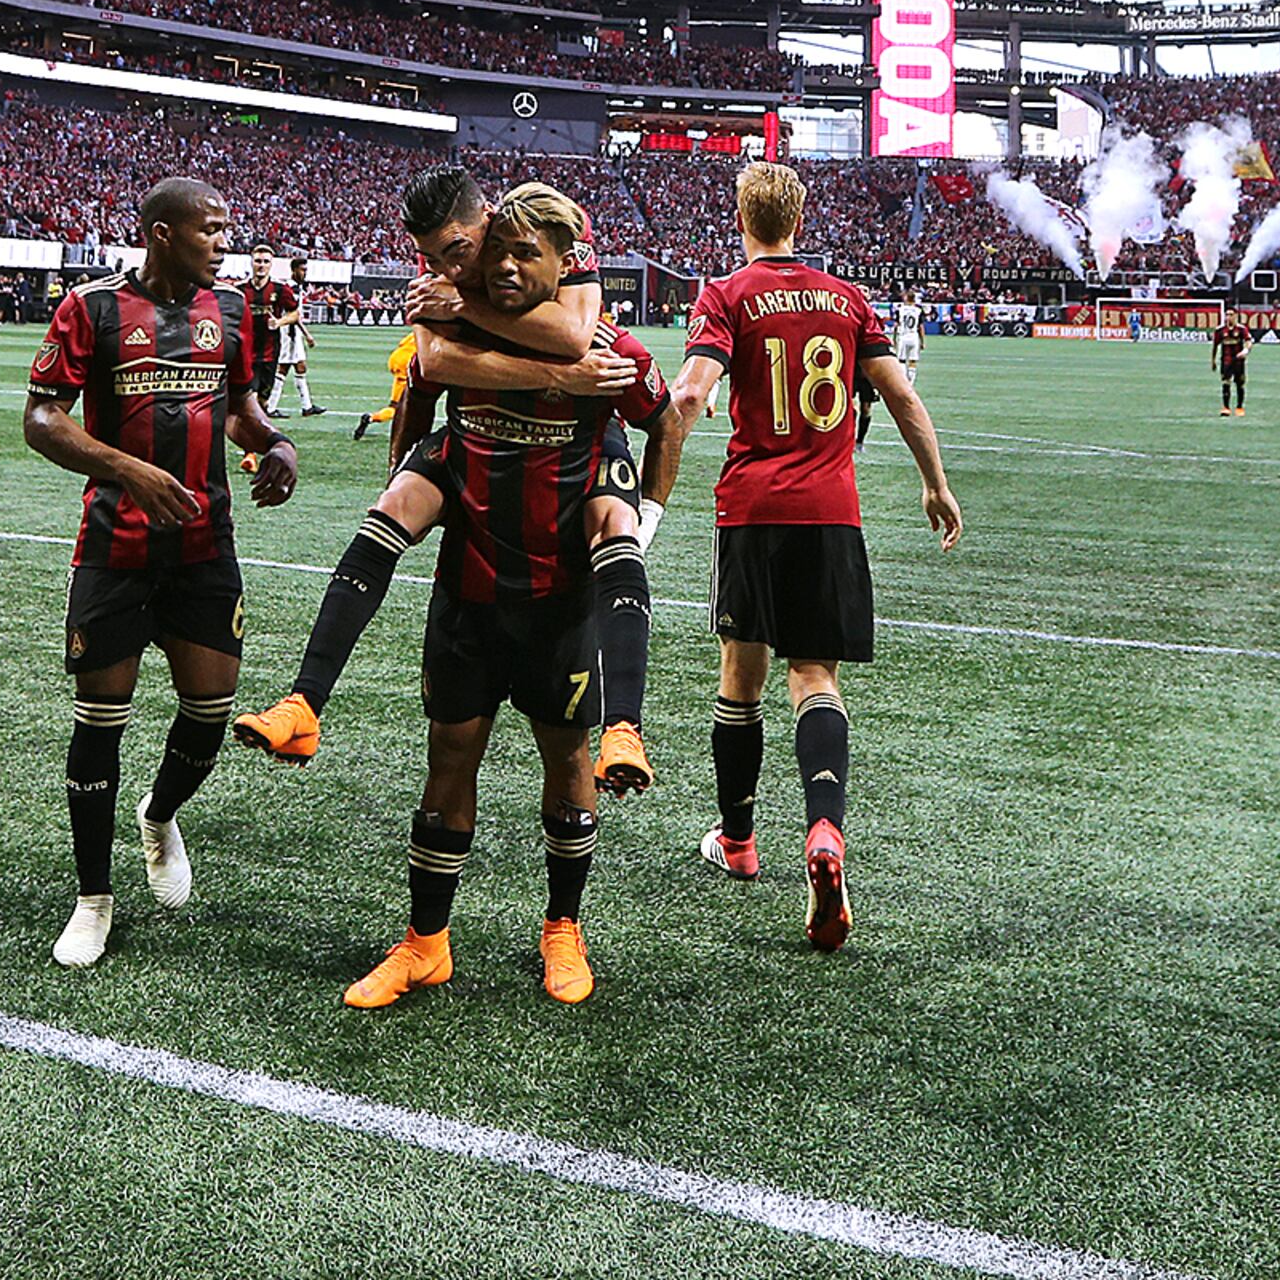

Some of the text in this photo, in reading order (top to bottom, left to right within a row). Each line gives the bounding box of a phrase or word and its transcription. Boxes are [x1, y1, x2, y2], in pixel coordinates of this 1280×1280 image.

[1129, 16, 1239, 31] Mercedes-Benz
[836, 266, 948, 280] RESURGENCE
[983, 269, 1028, 280] ROWDY
[604, 277, 636, 291] UNITED
[743, 289, 850, 321] LARENTOWICZ
[1036, 327, 1057, 337] THE
[1060, 327, 1091, 338] HOME
[1139, 327, 1208, 341] Heineken
[115, 369, 223, 384] AMERICAN FAMILY
[765, 335, 848, 435] 18
[528, 424, 575, 437] FAMILY
[598, 457, 637, 491] 10
[564, 671, 593, 719] 7
